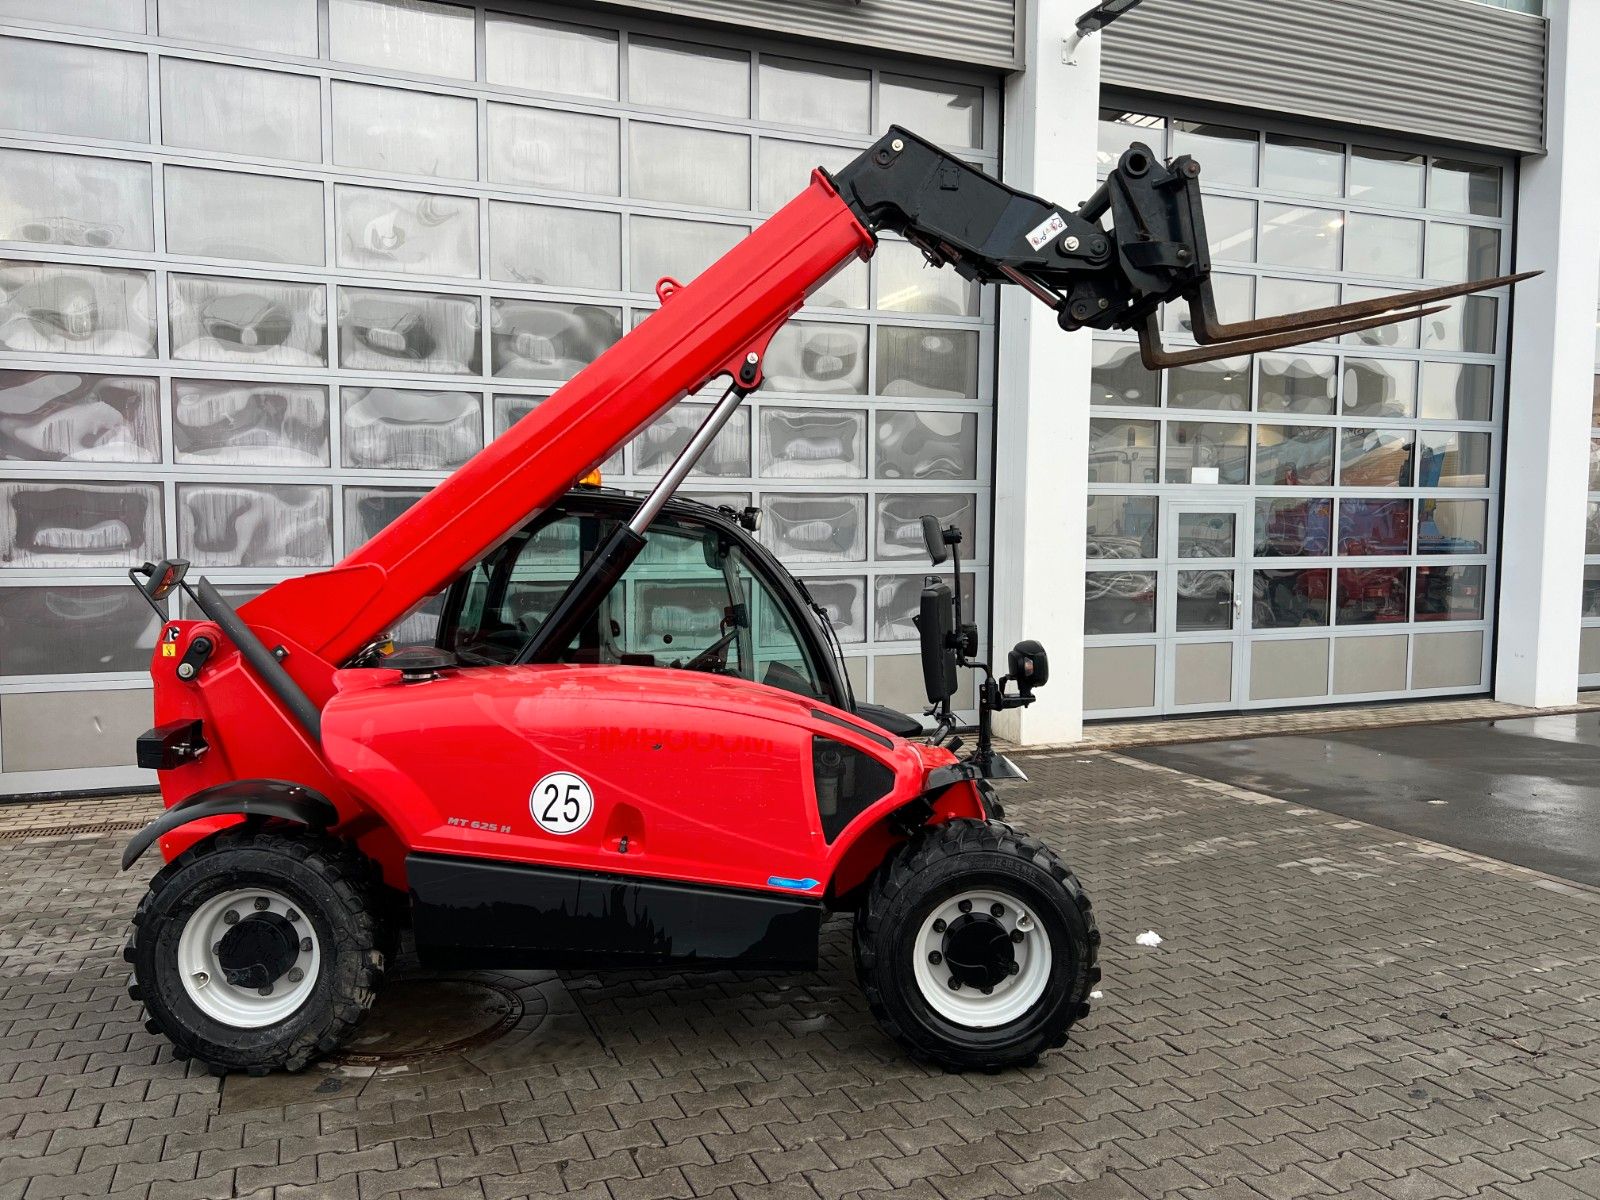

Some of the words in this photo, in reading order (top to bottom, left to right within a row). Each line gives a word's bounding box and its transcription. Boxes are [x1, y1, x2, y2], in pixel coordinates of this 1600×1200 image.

[542, 783, 580, 822] 25
[447, 817, 469, 827] MT
[470, 821, 498, 831] 625
[500, 825, 511, 833] H
